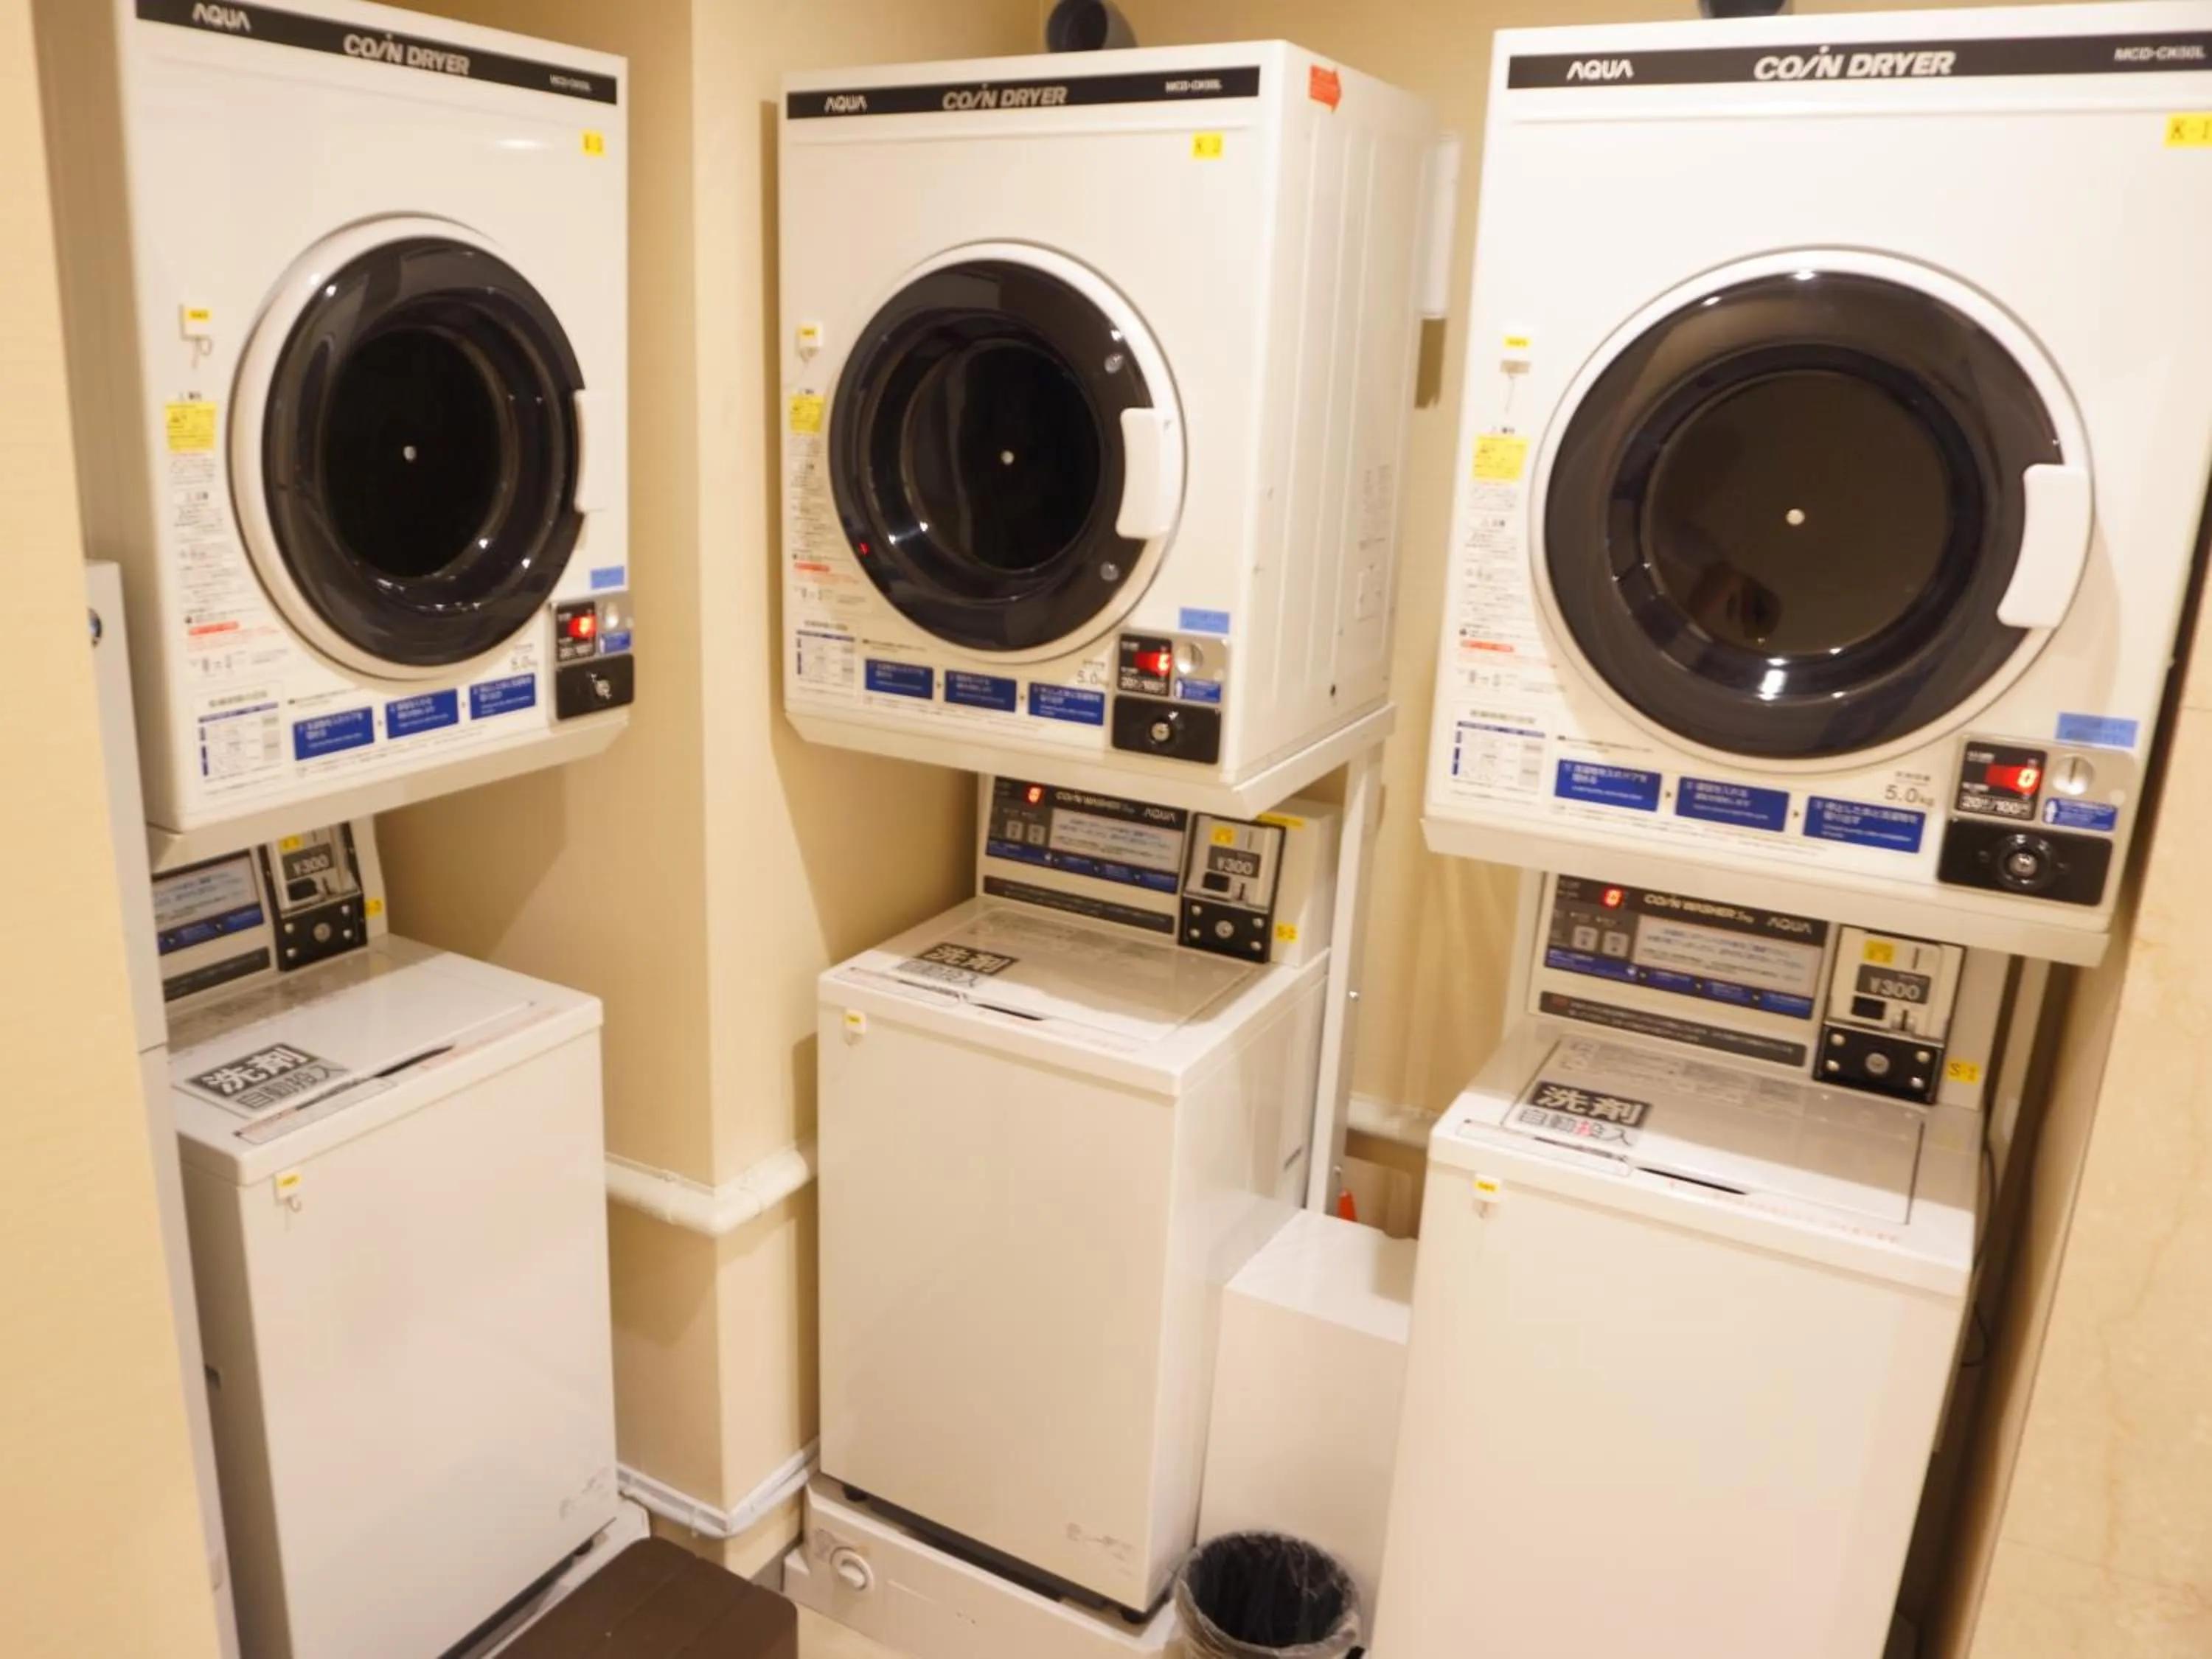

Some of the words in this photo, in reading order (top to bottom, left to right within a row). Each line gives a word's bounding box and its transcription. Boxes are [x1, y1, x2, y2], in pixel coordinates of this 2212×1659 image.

[192, 2, 251, 32] AQUA
[406, 41, 470, 75] DRYER
[1567, 58, 1633, 81] AQUA
[1846, 51, 1956, 78] DRYER
[824, 94, 868, 113] AQUA
[999, 86, 1068, 108] DRYER
[1767, 916, 1812, 935] AQUA
[201, 1047, 309, 1094] 洗剤
[1536, 1085, 1644, 1124] 洗剤
